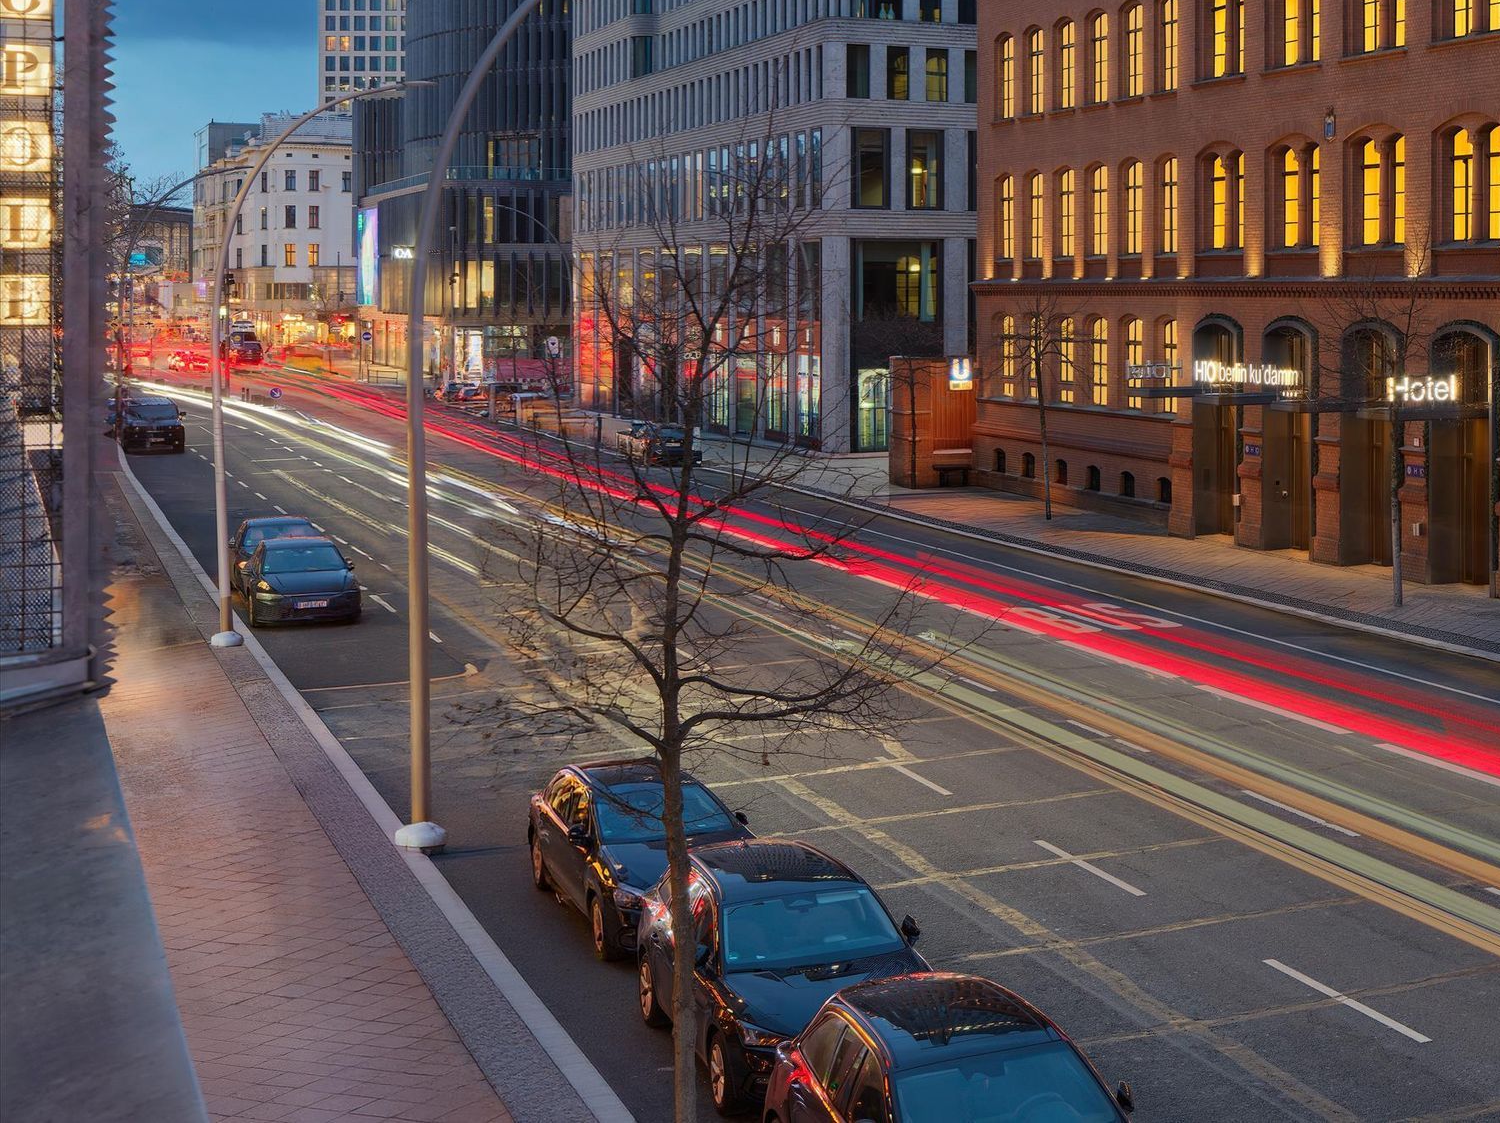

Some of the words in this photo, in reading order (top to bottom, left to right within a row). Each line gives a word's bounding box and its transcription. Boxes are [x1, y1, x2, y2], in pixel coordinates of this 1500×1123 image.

[953, 358, 970, 379] U
[1195, 360, 1216, 383] H10
[1218, 362, 1247, 383] berlin
[1249, 364, 1299, 386] ku'damm
[1387, 374, 1456, 402] Hotel
[1001, 603, 1183, 634] BUS
